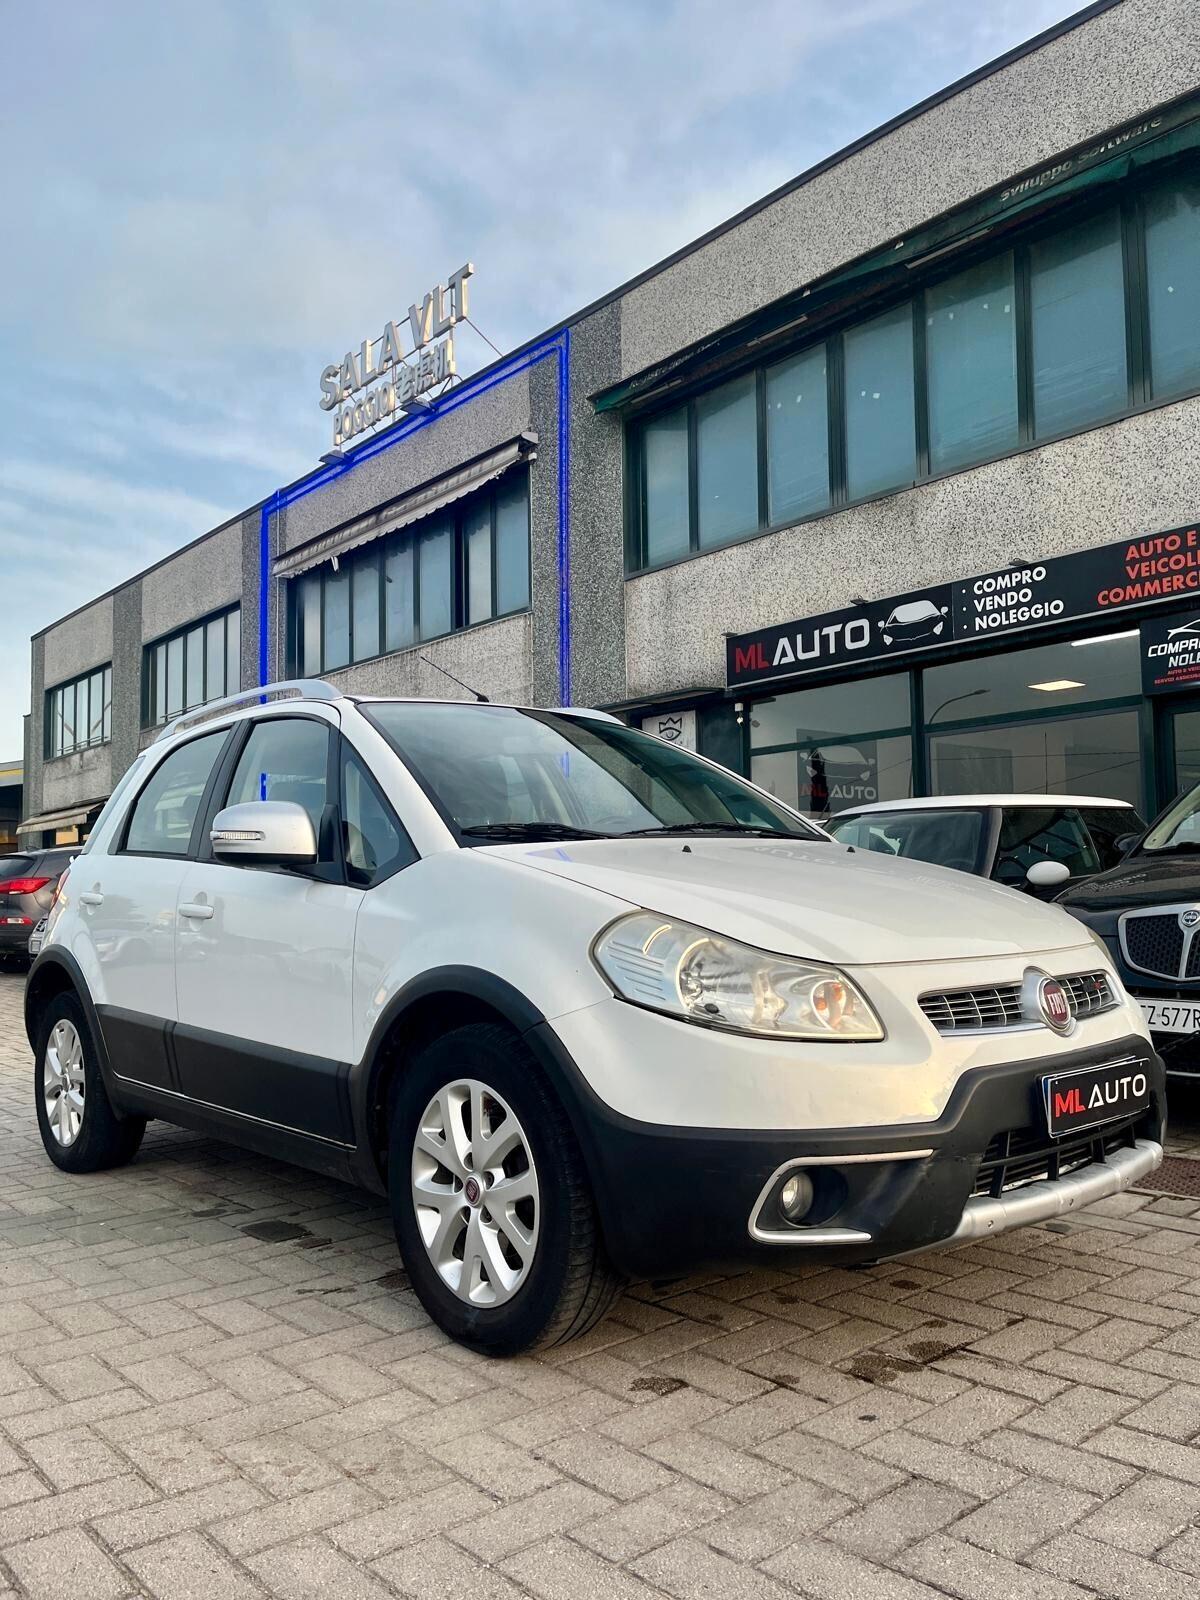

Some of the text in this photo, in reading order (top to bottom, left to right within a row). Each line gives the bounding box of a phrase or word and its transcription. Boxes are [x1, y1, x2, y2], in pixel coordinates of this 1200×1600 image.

[319, 263, 474, 411] SALA VLT
[333, 381, 395, 446] POGGIO
[1126, 530, 1197, 560] AUTO E
[973, 566, 1047, 595] COMPRO
[973, 588, 1032, 612] VENDO
[975, 599, 1064, 631] NOLEGGIO
[772, 618, 870, 666] AUTO
[1148, 638, 1200, 657] COMPR
[830, 784, 877, 800] AUTO
[1047, 992, 1066, 1015] FIAT
[1055, 1073, 1147, 1118] ML AUTO
